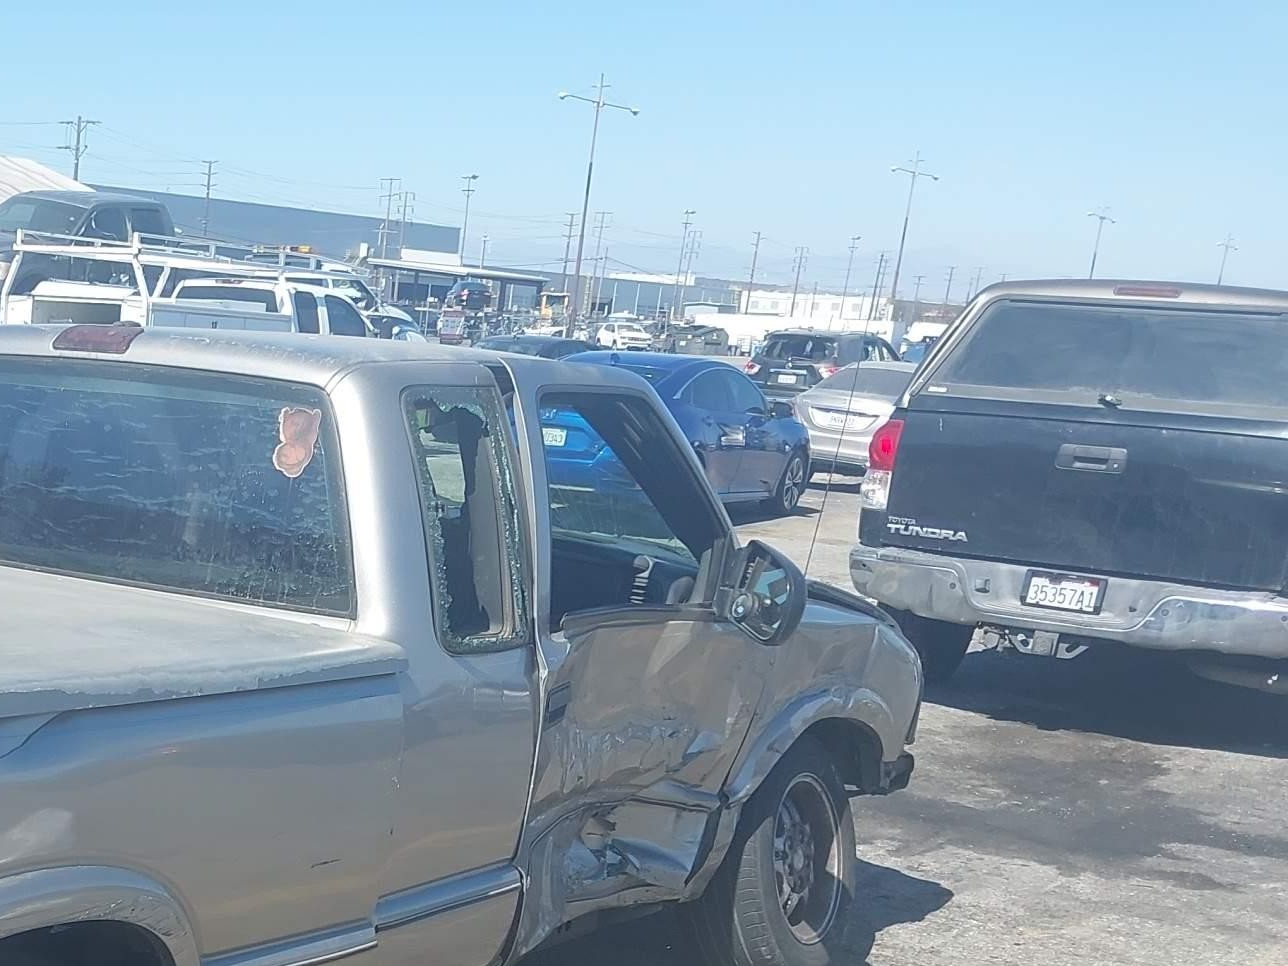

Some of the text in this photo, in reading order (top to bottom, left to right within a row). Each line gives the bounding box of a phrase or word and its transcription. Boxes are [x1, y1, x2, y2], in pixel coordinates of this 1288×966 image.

[888, 515, 916, 525] TOYOTA
[887, 524, 968, 542] TUNDRA
[1029, 584, 1094, 609] 35357A1
